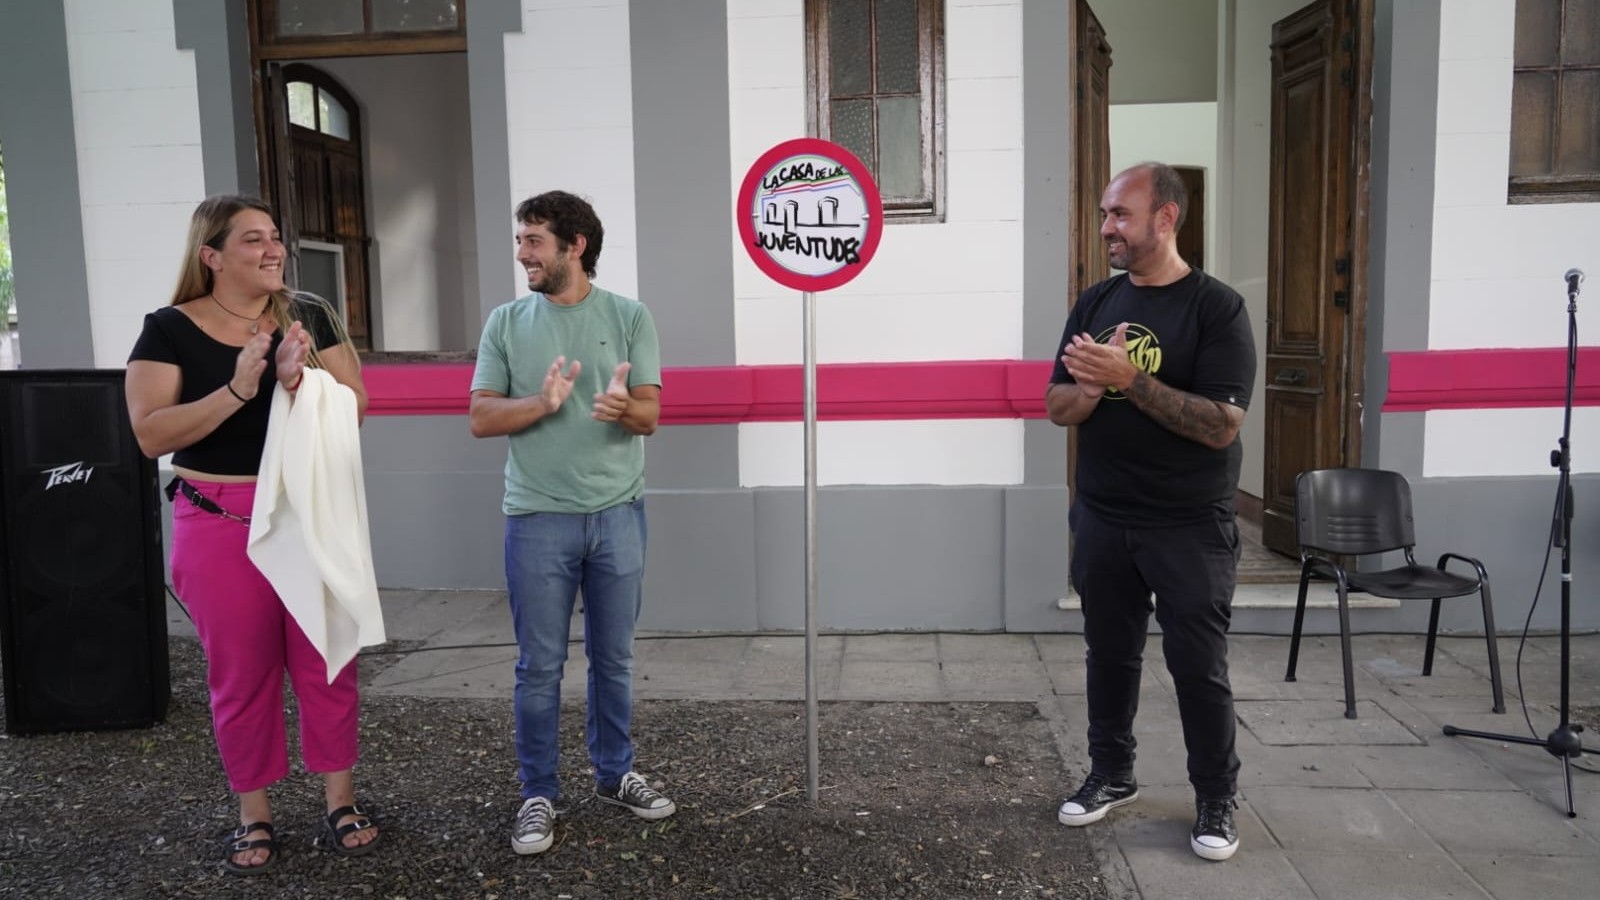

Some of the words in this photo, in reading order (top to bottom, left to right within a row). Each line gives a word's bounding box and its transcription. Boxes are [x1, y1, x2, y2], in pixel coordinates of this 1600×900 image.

[763, 175, 779, 190] LA
[779, 163, 814, 180] CASA
[815, 167, 826, 180] DE
[829, 165, 844, 177] LAS
[754, 232, 861, 265] JUVENTUDES
